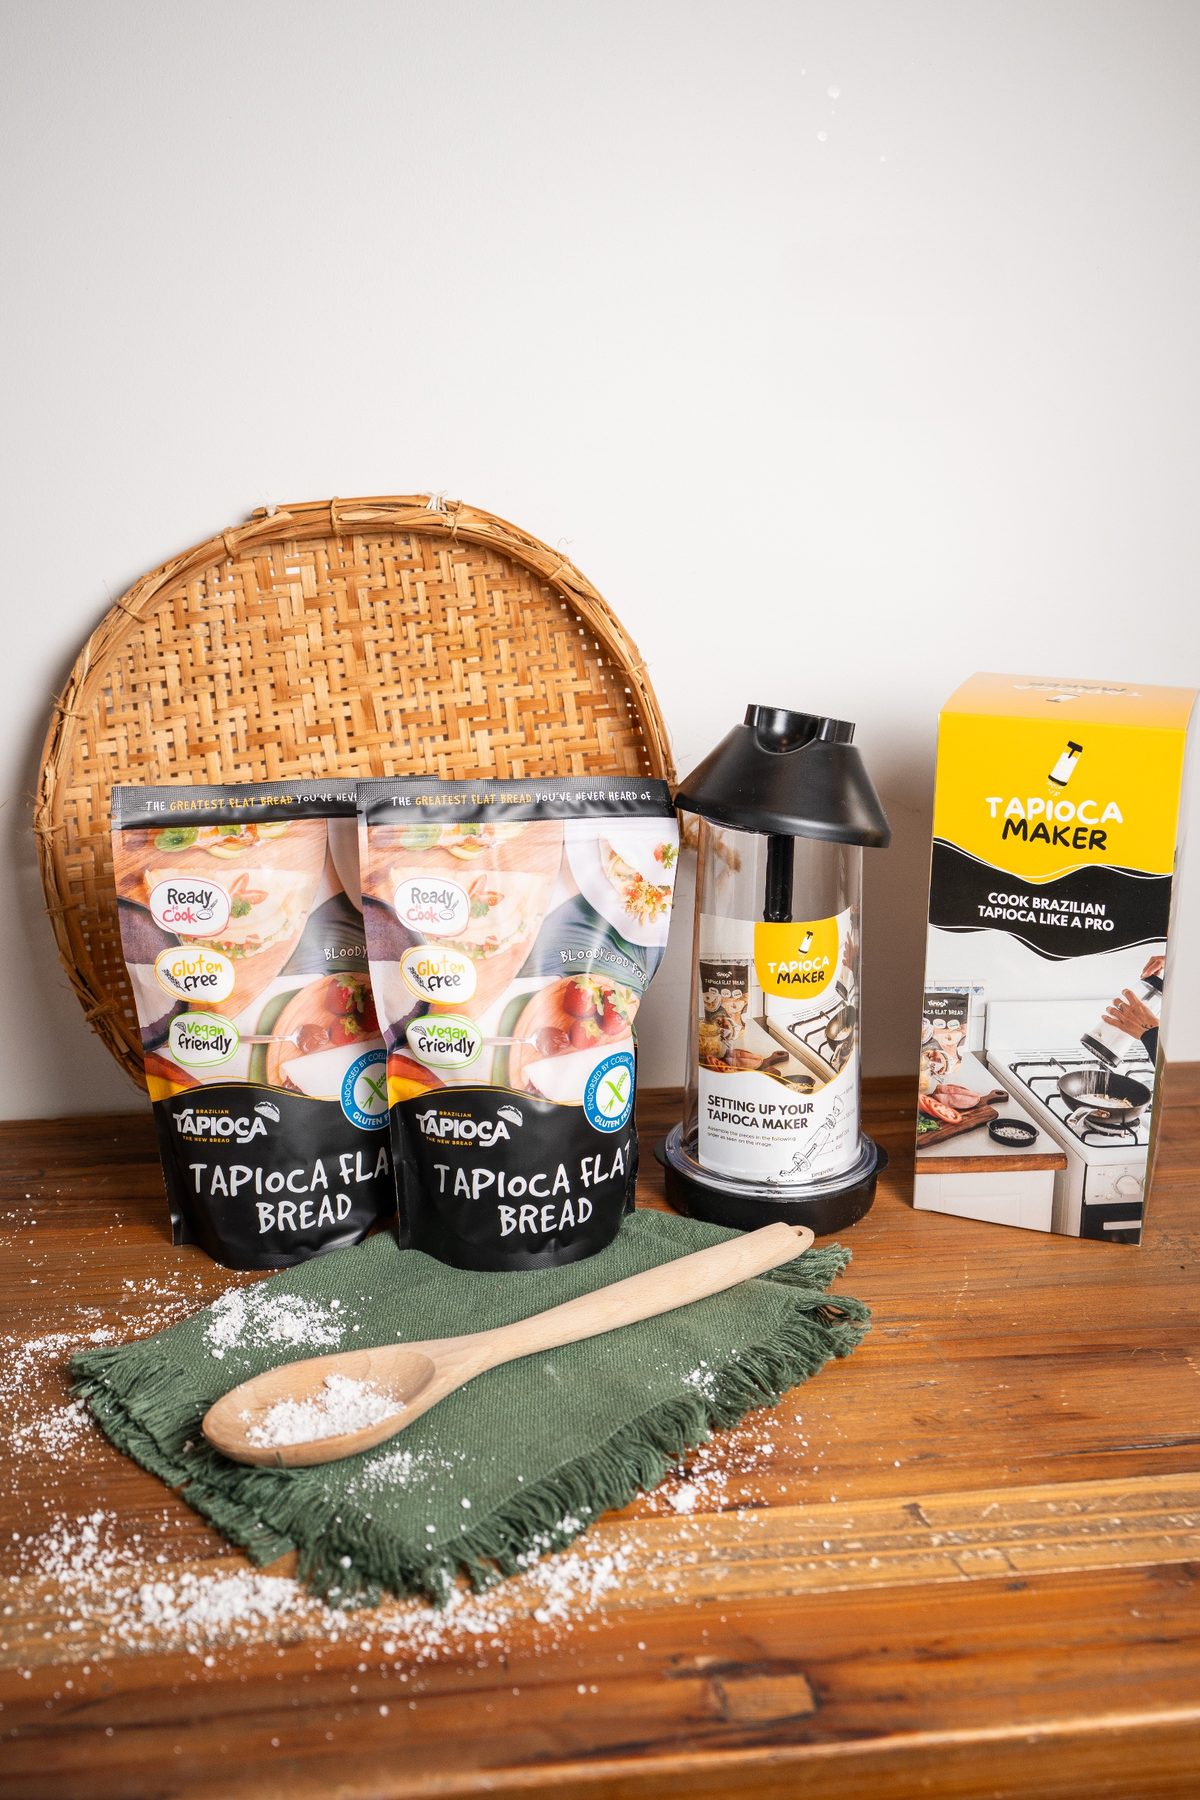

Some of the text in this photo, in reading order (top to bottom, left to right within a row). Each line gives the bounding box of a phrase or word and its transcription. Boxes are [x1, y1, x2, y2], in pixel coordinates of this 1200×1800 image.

[146, 801, 167, 812] THE
[169, 798, 224, 811] GREATEST
[228, 797, 256, 808] FLAT
[260, 795, 293, 806] BREAD
[296, 792, 333, 804] YOU'VE
[391, 791, 652, 806] THE GREATEST FLAT BREAD YOU'VE NEVER HEARD OF
[985, 797, 1123, 825] TAPIOCA
[1001, 818, 1108, 851] MAKER
[167, 888, 213, 909] Ready
[411, 887, 455, 909] Ready
[987, 892, 1106, 916] COOK BRAZILIAN
[162, 907, 198, 924] Cook
[407, 906, 440, 923] Cook
[978, 905, 1115, 932] TAPIOCA LIKE A PRO
[172, 953, 223, 977] Gluten
[417, 953, 465, 976] Gluten
[560, 947, 606, 963] BLOODY
[605, 951, 629, 967] GOOD
[767, 956, 830, 974] TAPIOCA
[184, 974, 218, 992] free
[428, 974, 461, 992] free
[776, 971, 825, 985] MAKER
[178, 1033, 232, 1055] friendly
[418, 1037, 475, 1058] friendly
[344, 1066, 360, 1107] ENDORSED
[359, 1058, 367, 1068] BY
[586, 1070, 602, 1111] ENDORSED
[602, 1061, 609, 1072] BY
[438, 1110, 472, 1118] BRAZILIAN
[707, 1094, 815, 1116] SETTING UP YOUR
[172, 1108, 268, 1144] TAPIOCA
[353, 1111, 383, 1126] GLUTEN
[415, 1109, 511, 1147] TAPIOCA
[594, 1115, 620, 1128] GLUTEN
[707, 1108, 809, 1130] TAPIOCA MAKER
[188, 1146, 389, 1197] TAPIOCA FLA
[433, 1163, 571, 1200] TAPIOCA
[255, 1193, 352, 1235] BREAD
[497, 1196, 594, 1237] BREAD
